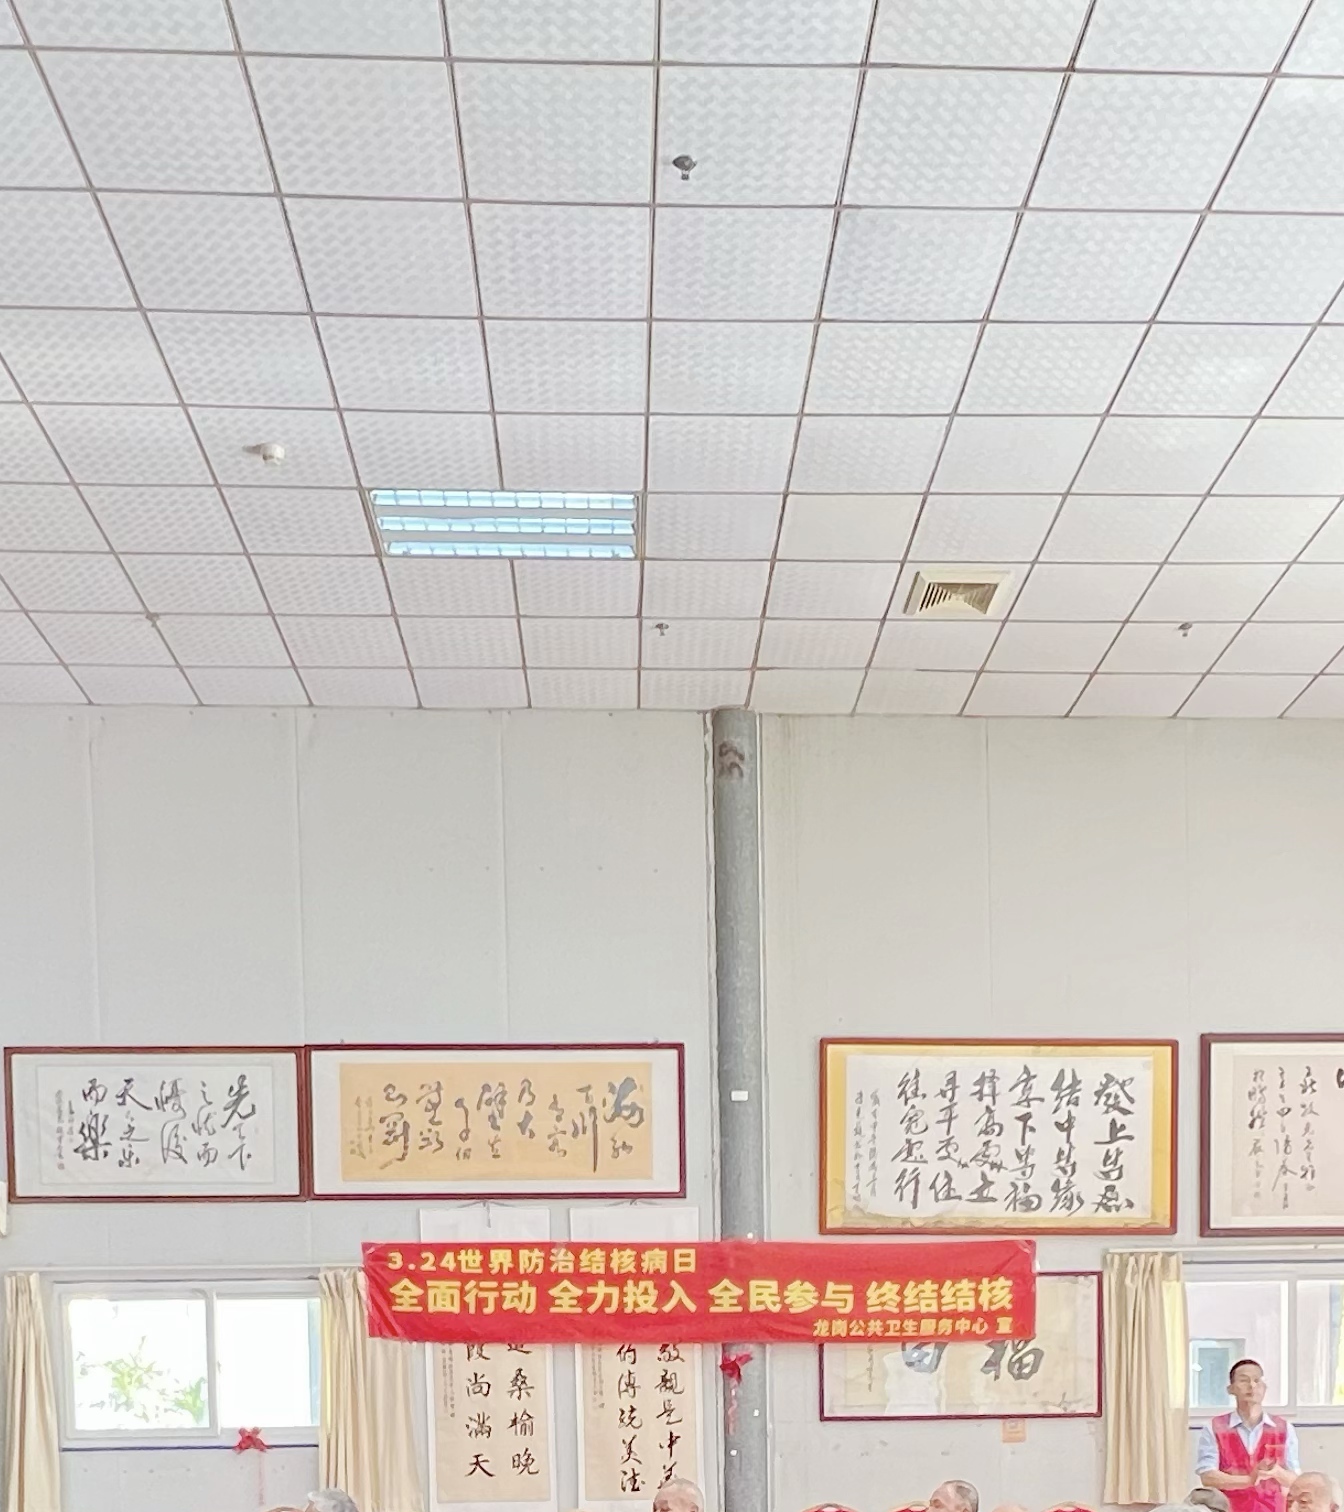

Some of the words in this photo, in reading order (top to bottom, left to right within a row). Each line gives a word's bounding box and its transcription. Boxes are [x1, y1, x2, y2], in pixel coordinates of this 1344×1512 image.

[387, 1248, 697, 1275] 3.24世界防治结核病日
[389, 1277, 537, 1315] 全面行动
[548, 1278, 697, 1314] 全力投入
[708, 1278, 855, 1313] 全民参与
[866, 1276, 1014, 1314] 终结结核
[812, 1317, 989, 1337] 龙岗公共卫生服务中心
